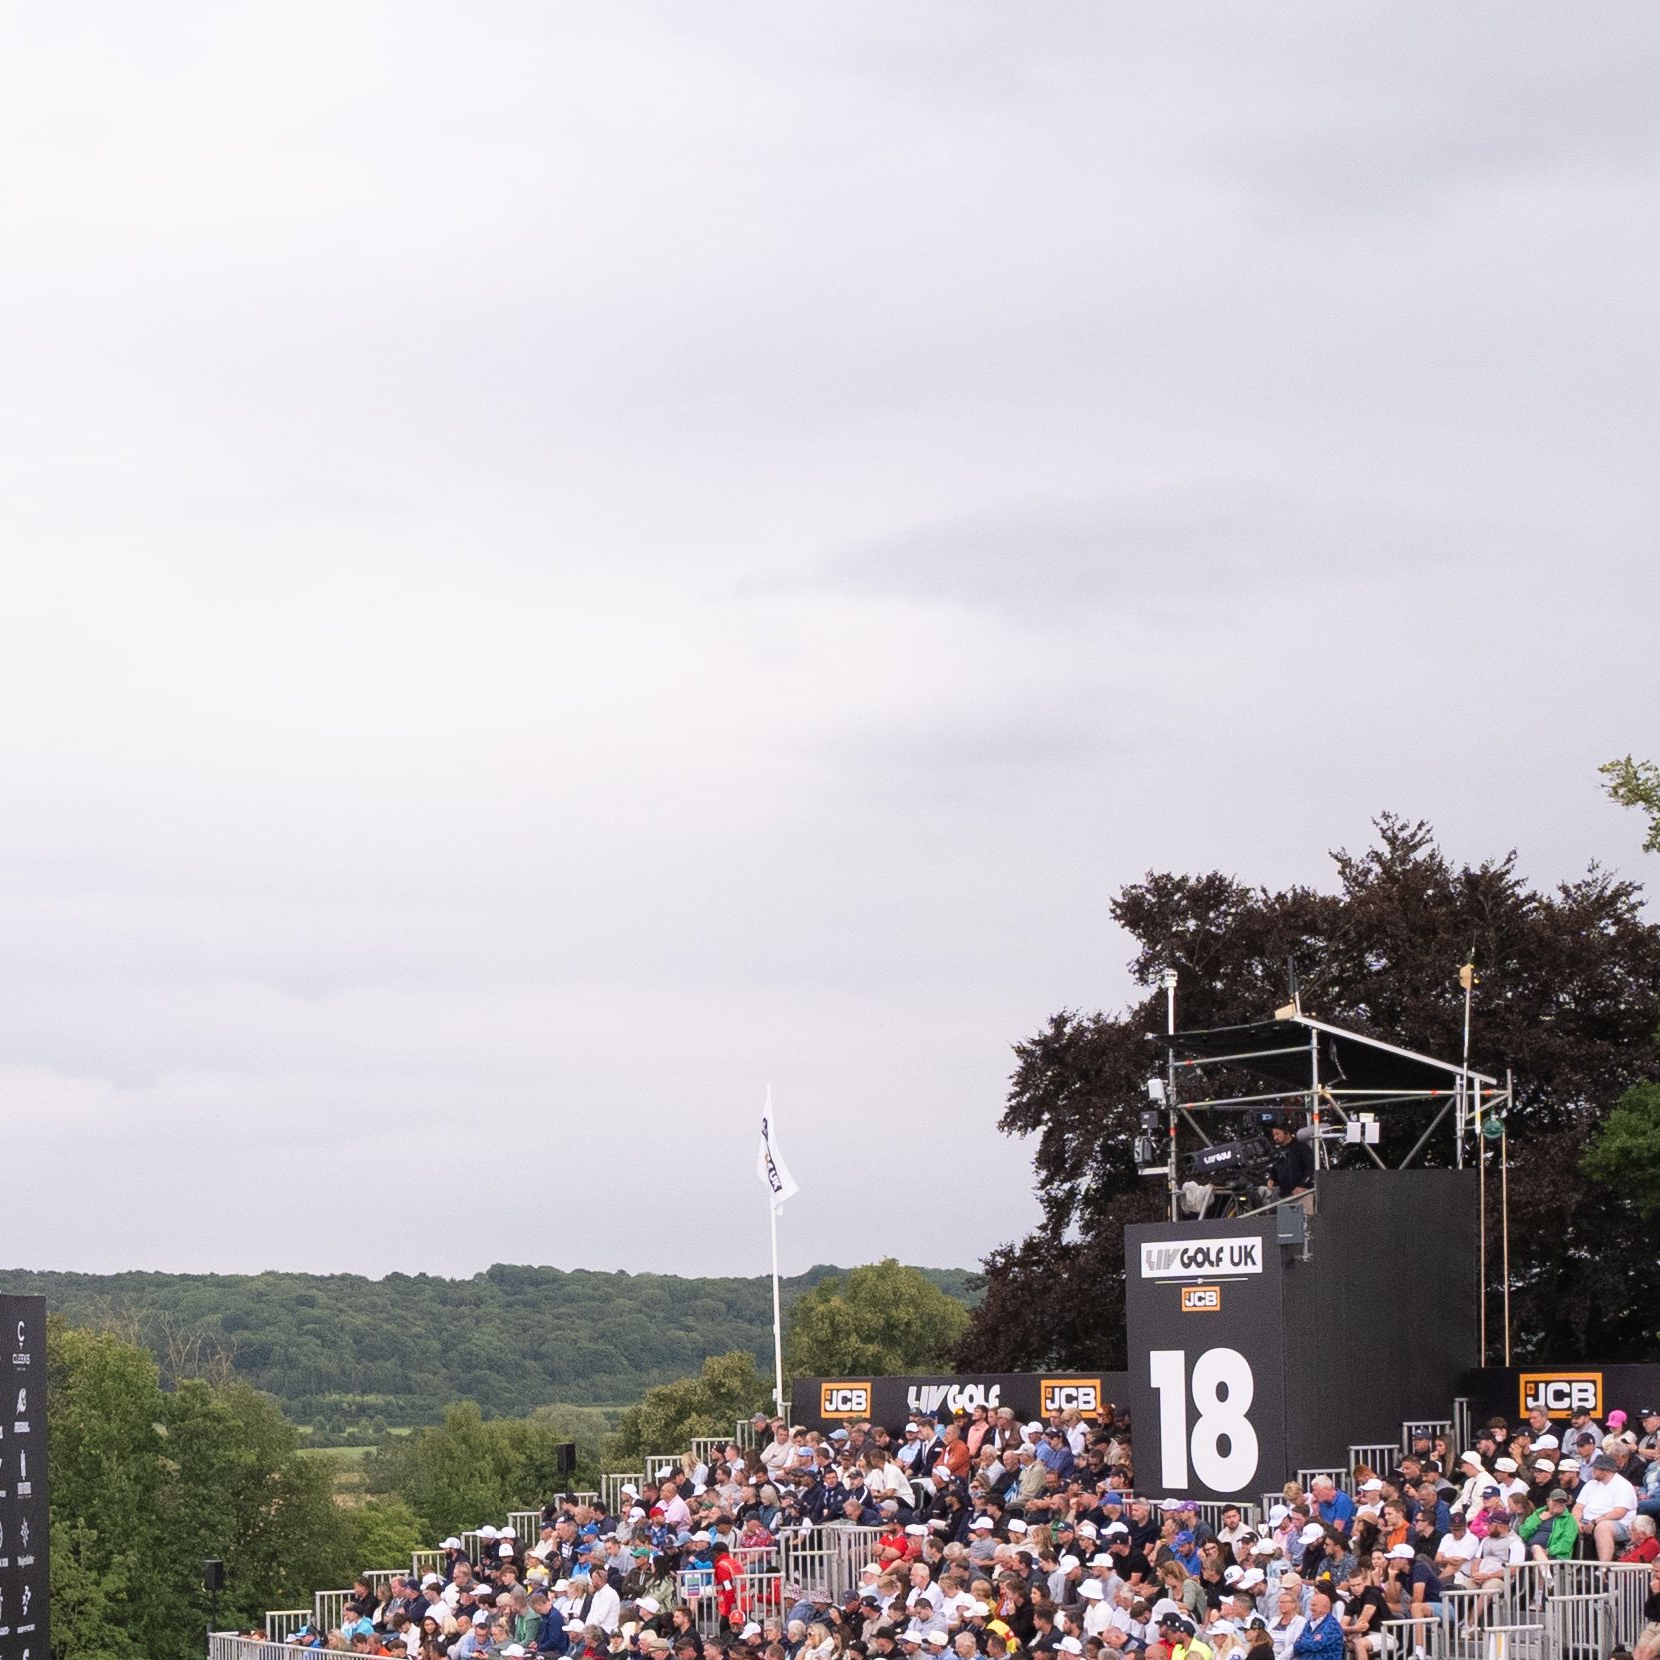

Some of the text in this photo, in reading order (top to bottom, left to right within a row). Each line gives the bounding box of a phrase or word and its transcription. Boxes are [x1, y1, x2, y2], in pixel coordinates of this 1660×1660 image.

[1181, 1246, 1223, 1270] GOLF
[1230, 1244, 1257, 1267] UK
[1185, 1290, 1217, 1307] JCB
[825, 1389, 867, 1411] JCB
[946, 1384, 1000, 1415] GOLF
[1046, 1387, 1096, 1410] JCB
[1526, 1382, 1596, 1409] JCB
[1150, 1347, 1259, 1493] 18
